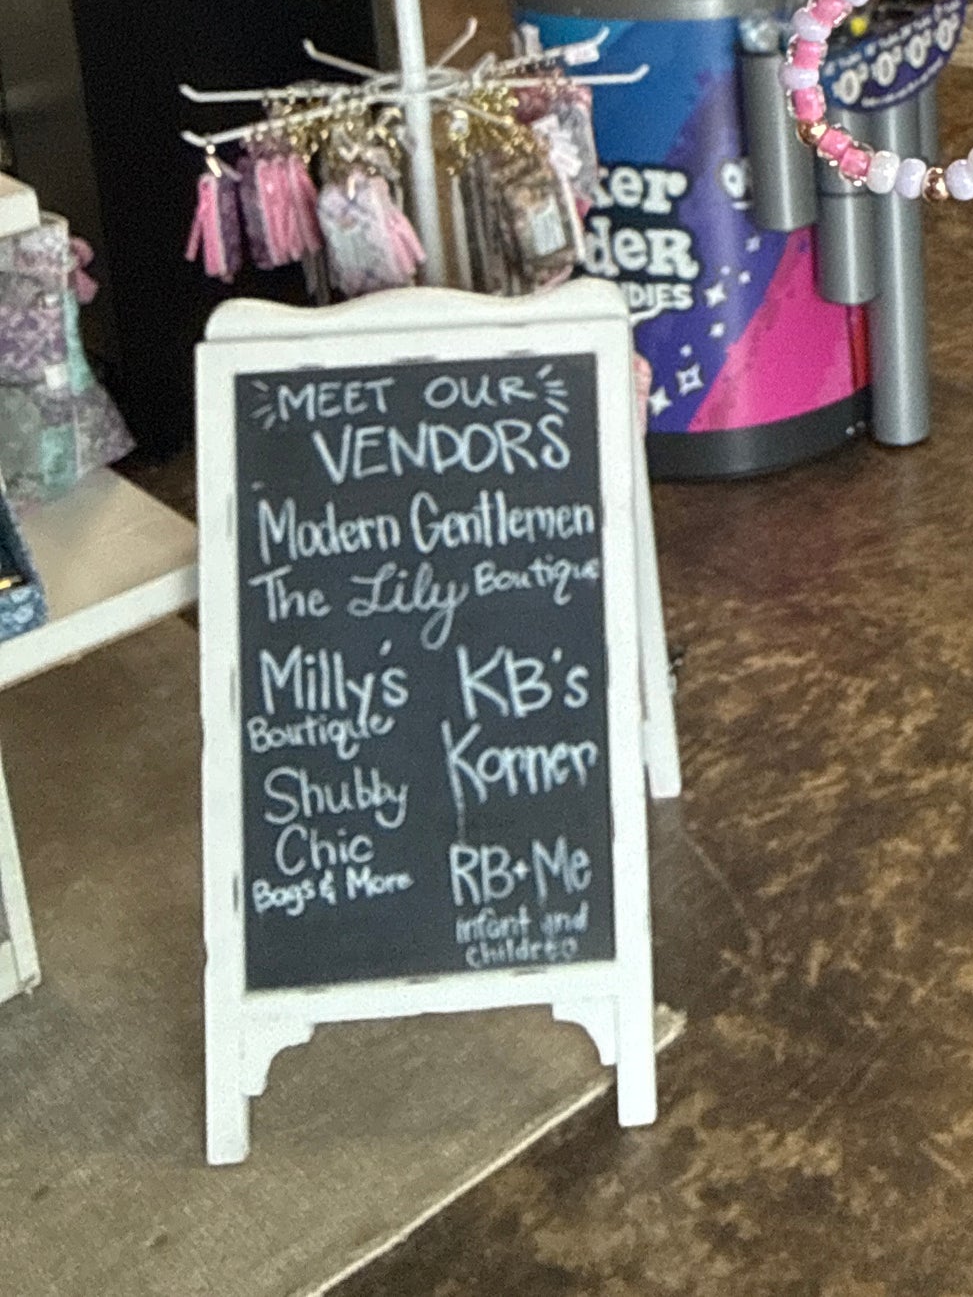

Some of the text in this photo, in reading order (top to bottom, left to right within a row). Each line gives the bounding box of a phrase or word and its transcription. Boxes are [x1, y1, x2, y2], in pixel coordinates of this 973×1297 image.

[276, 375, 537, 422] MEET OUR
[312, 413, 571, 485] VENDORS
[258, 489, 596, 565] Modern Gentlemen
[248, 555, 601, 651] The Lily Boutique
[259, 638, 410, 716] Milly's
[456, 644, 590, 720] KB's
[247, 713, 396, 761] Boutique
[275, 823, 376, 877] Chic
[252, 865, 415, 918] Bags & More
